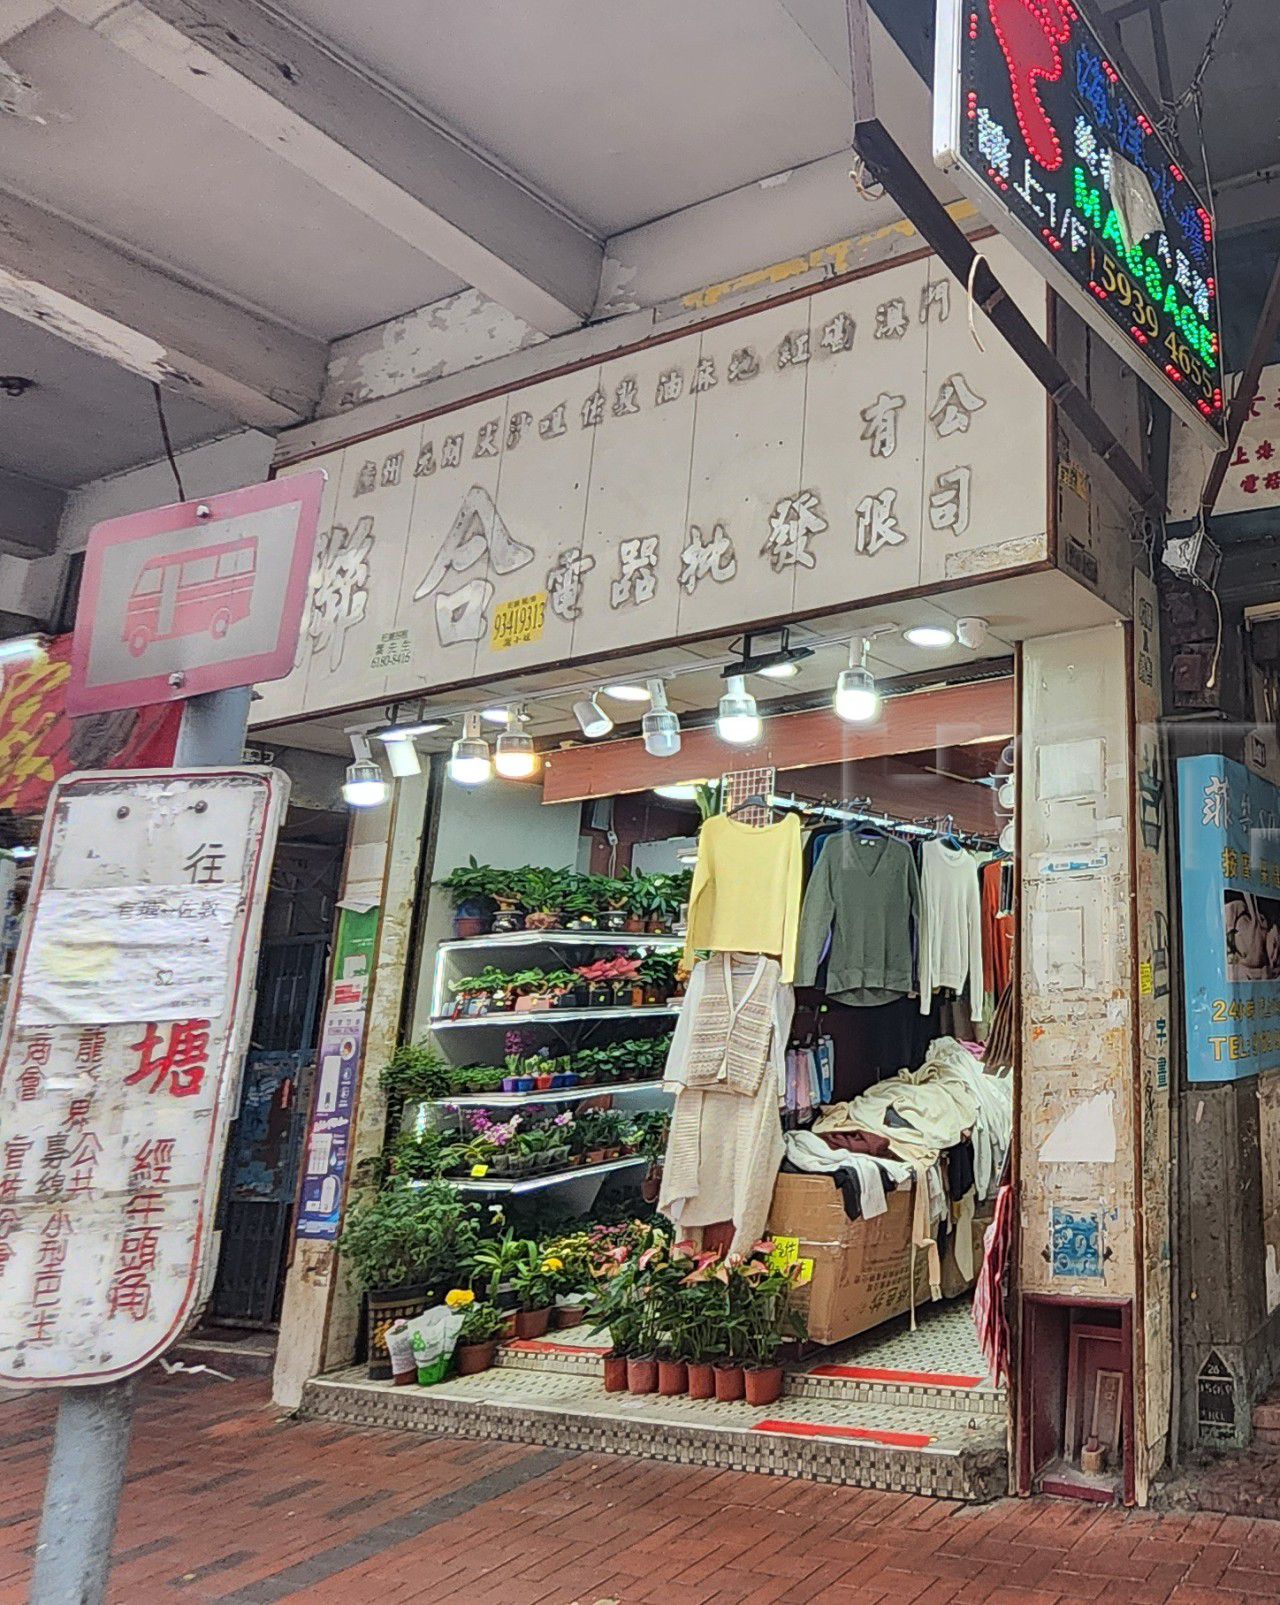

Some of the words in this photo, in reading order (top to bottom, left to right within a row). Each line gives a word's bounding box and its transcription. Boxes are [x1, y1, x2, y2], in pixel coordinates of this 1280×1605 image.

[1101, 255, 1158, 338] 5939
[1164, 331, 1214, 398] 4655
[183, 842, 226, 884] 往
[125, 1018, 212, 1098] 塘
